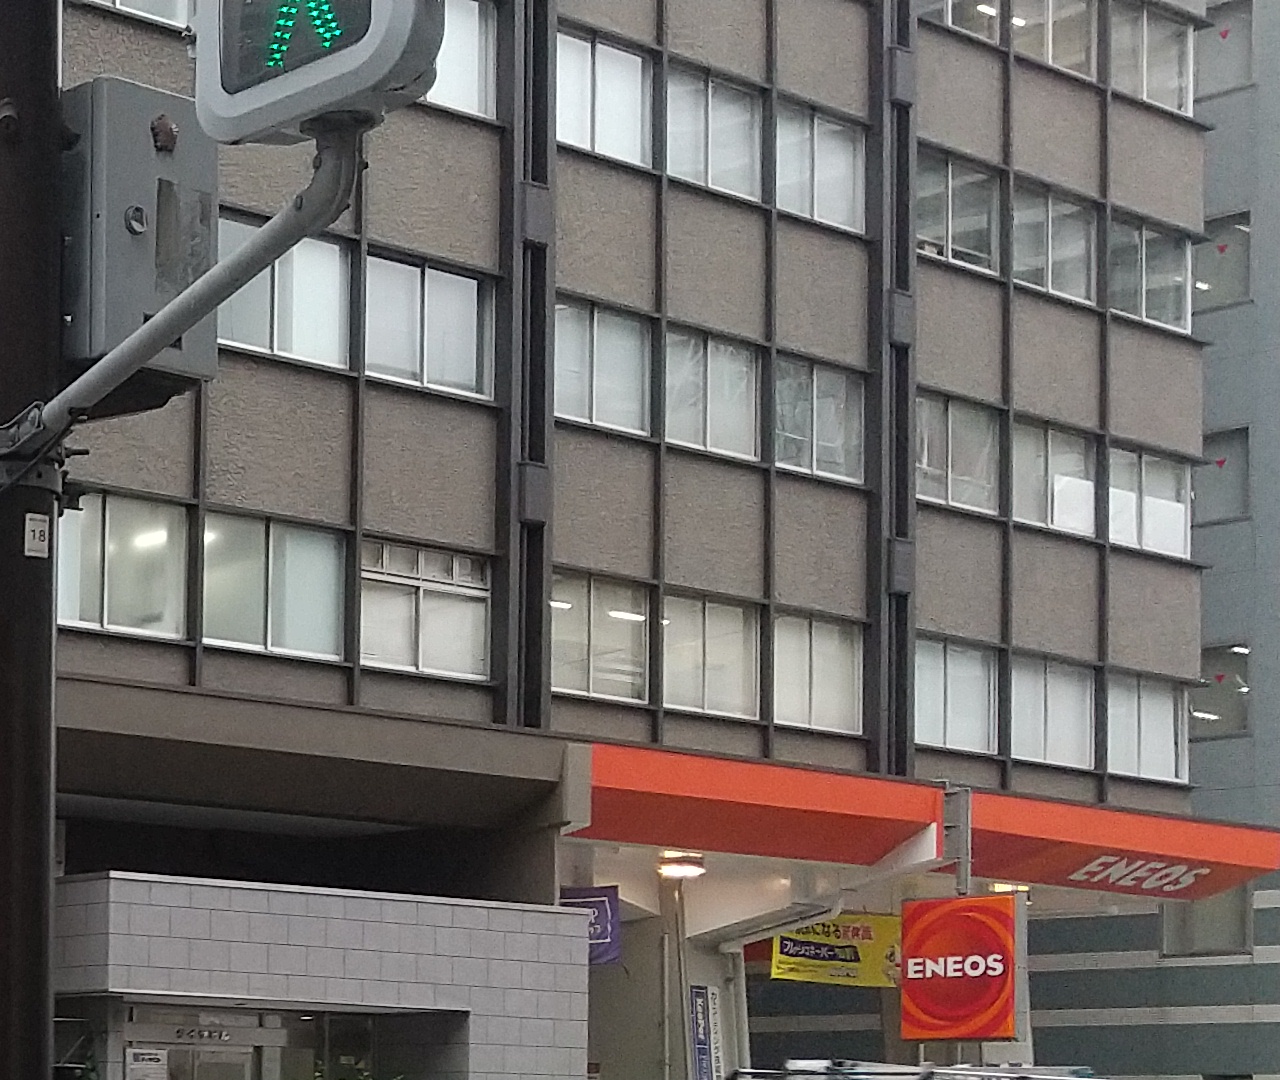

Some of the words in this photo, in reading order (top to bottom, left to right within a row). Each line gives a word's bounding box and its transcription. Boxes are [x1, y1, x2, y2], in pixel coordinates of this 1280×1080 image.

[30, 528, 47, 543] 18
[1068, 855, 1211, 892] ENEOS
[906, 953, 1005, 979] ENEOS
